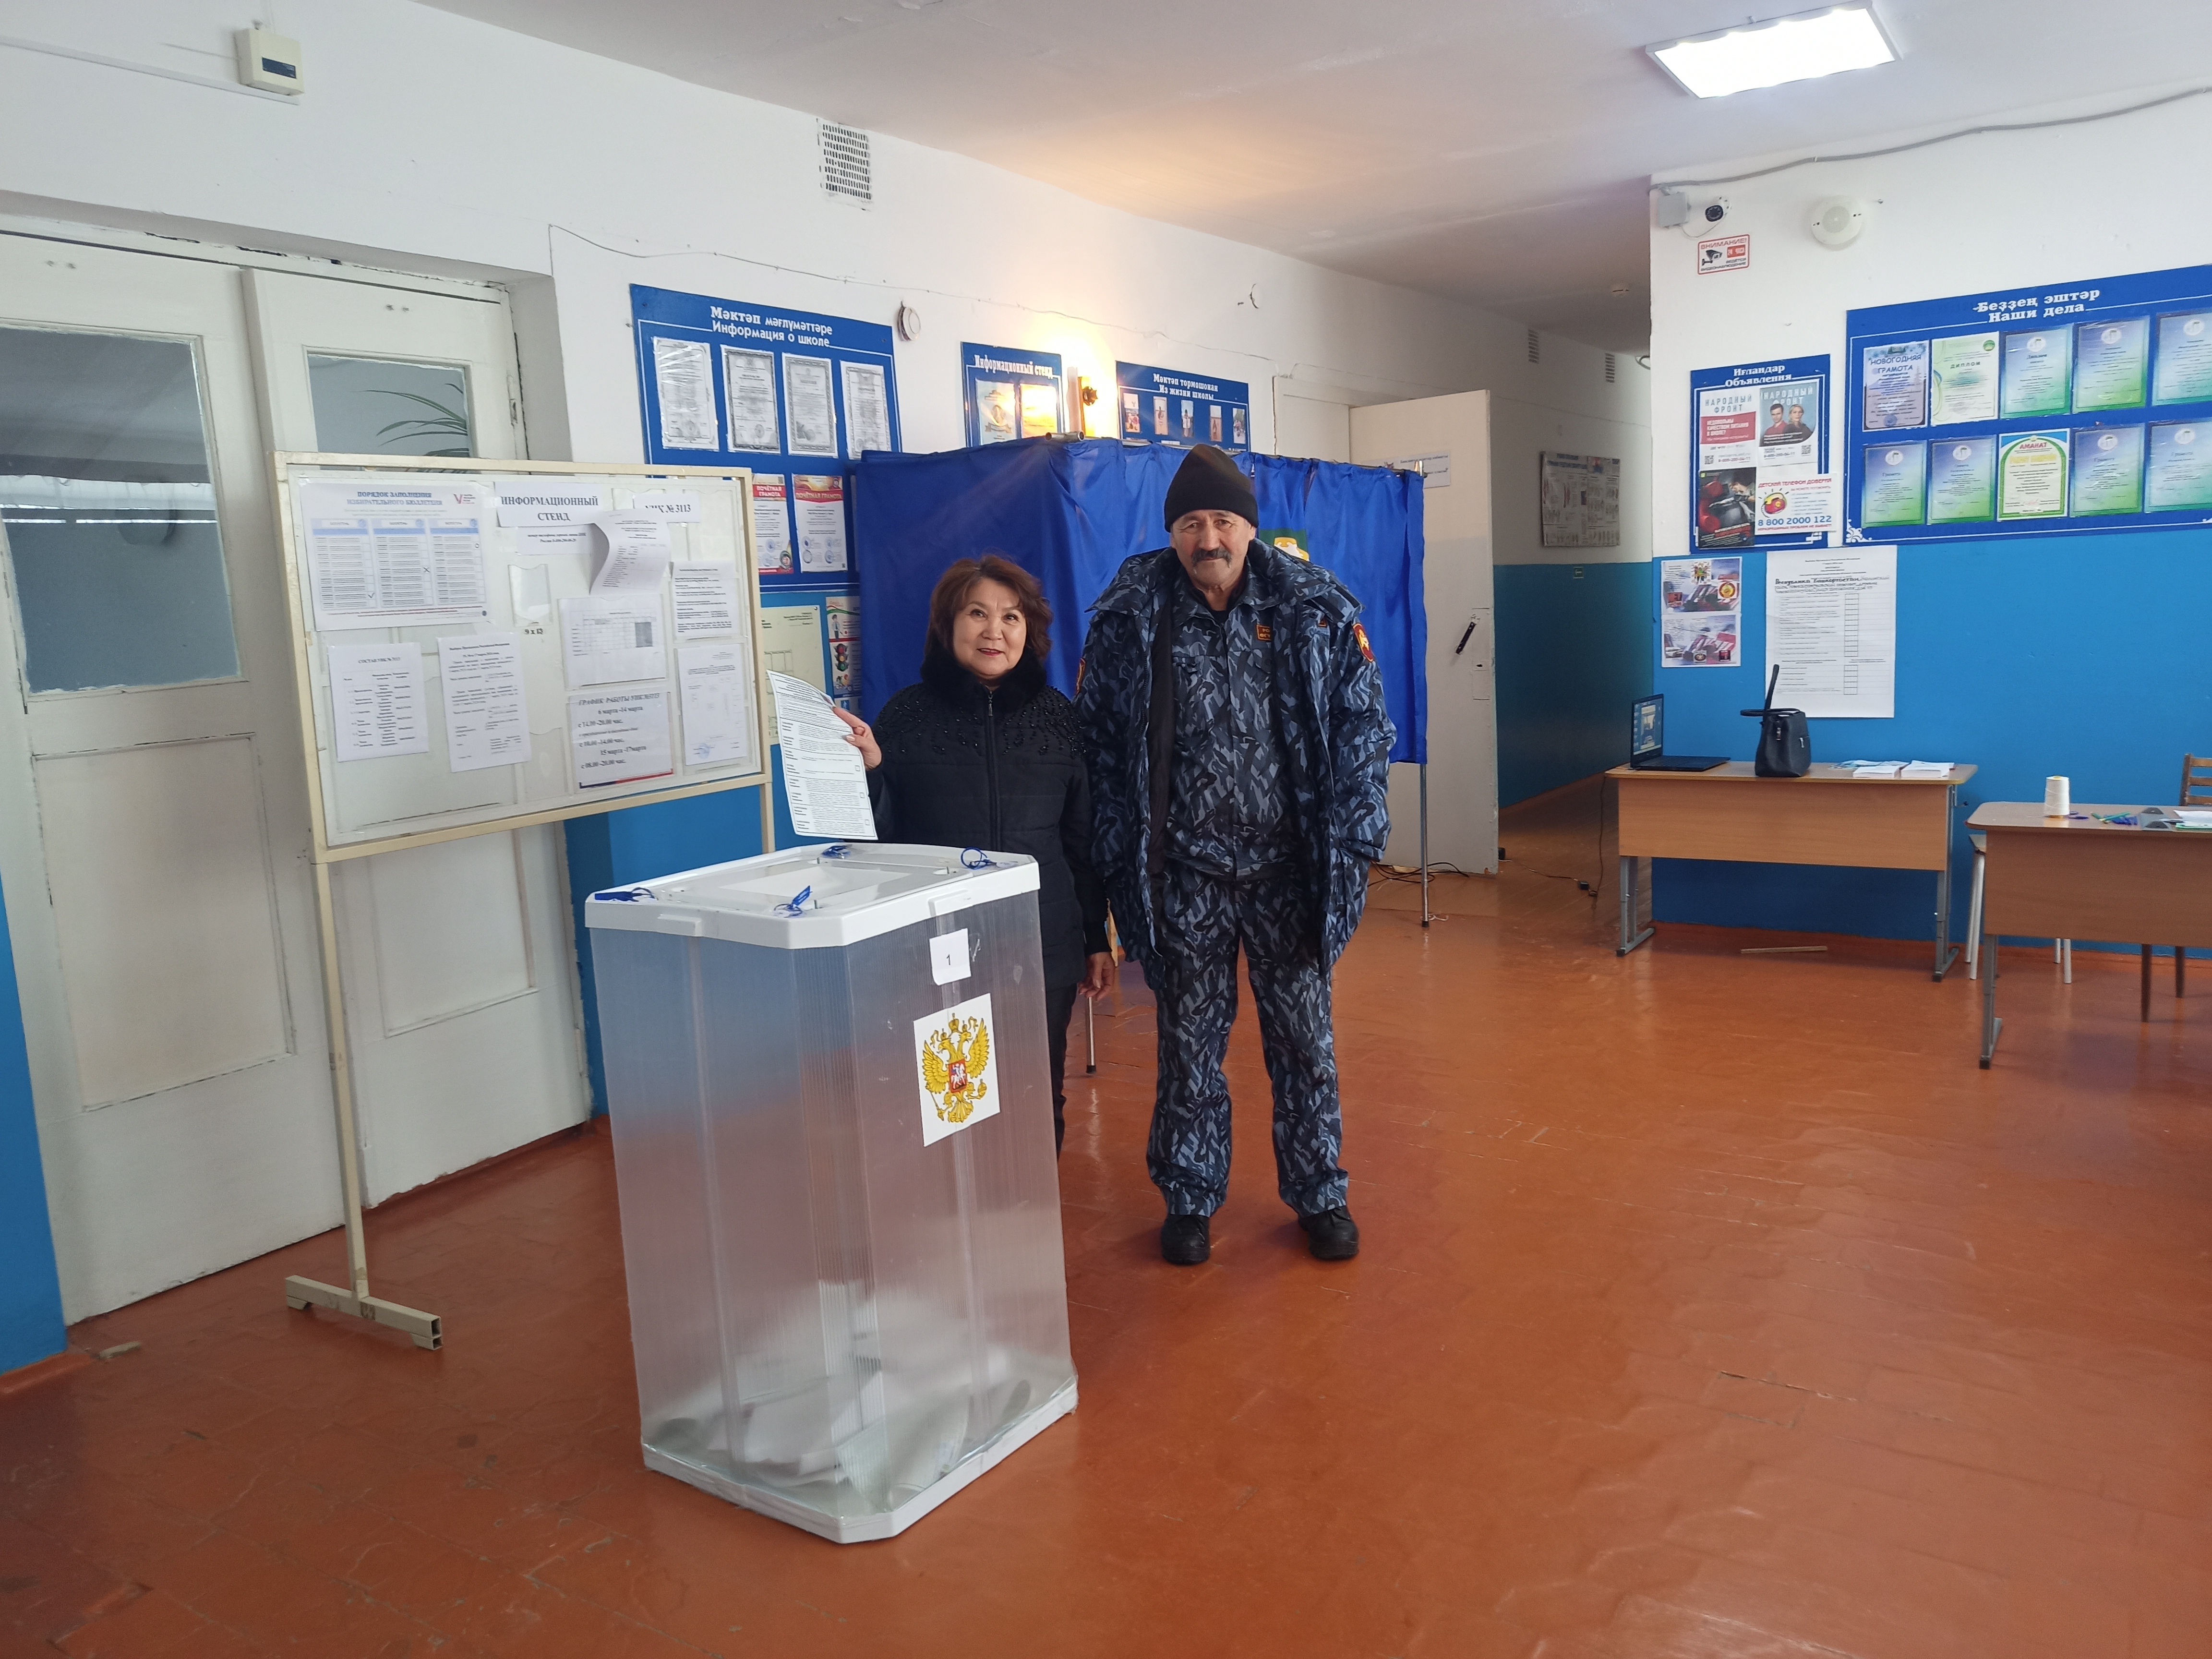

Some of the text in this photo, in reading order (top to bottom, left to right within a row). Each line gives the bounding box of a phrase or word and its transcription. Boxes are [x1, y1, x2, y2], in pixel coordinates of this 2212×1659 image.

[2044, 289, 2100, 303] эштәр
[710, 306, 761, 325] Мәктәп
[1988, 303, 2084, 323] Наши дела
[712, 320, 830, 348] Информация о школе
[1870, 354, 1922, 365] НОВОГОДНЯЯ
[974, 354, 1054, 379] Информационный стенд
[1733, 365, 1785, 376] Иғландар
[1878, 365, 1913, 373] ГРАМОТА
[1153, 373, 1179, 385] Мәктәп
[1725, 374, 1792, 387] Объявления
[1159, 385, 1214, 400] Из жизни школы
[1764, 386, 1813, 400] НАРОДНЫЙ
[1705, 395, 1752, 406] НАРОДНЫЙ
[1714, 404, 1743, 413] ФРОНТ
[501, 496, 599, 506] ИНФОРМАЦИОННЫЙ
[538, 513, 570, 521] СТЕНД
[1786, 517, 1811, 525] 2000
[946, 954, 951, 965] 1
